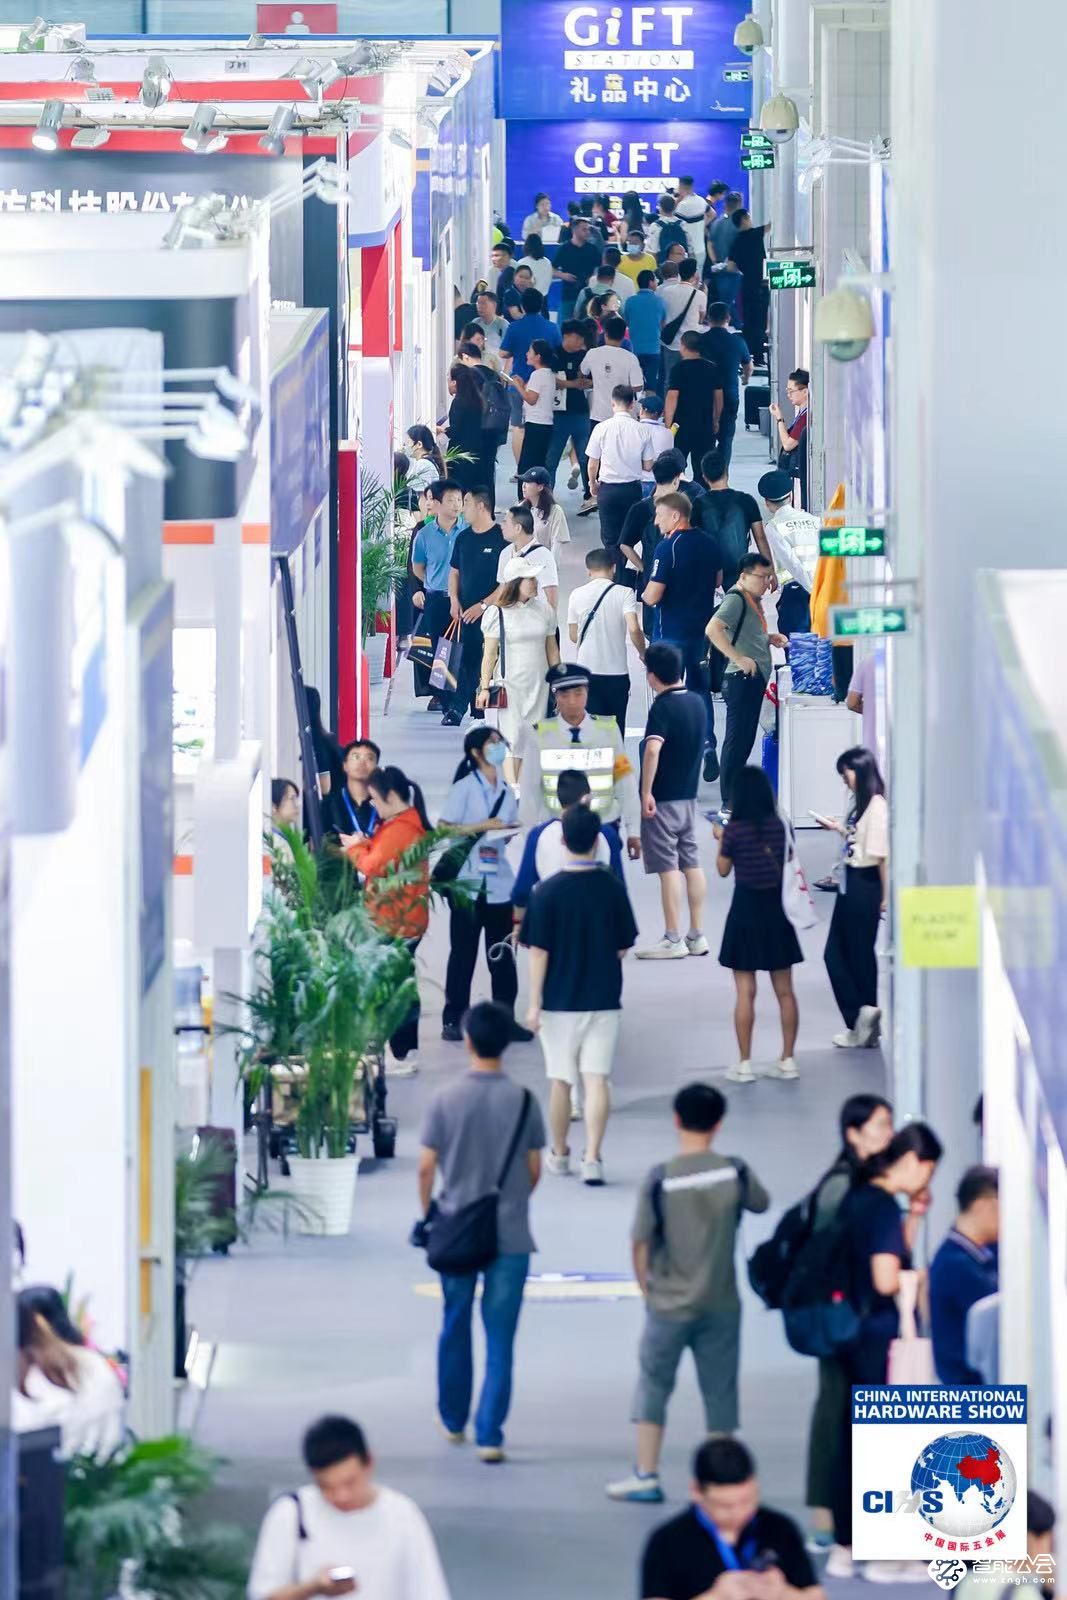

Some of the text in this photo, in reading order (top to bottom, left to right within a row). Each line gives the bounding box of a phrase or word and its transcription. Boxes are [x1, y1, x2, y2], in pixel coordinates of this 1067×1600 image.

[575, 54, 681, 67] STATION
[570, 73, 692, 103] 礼品中心
